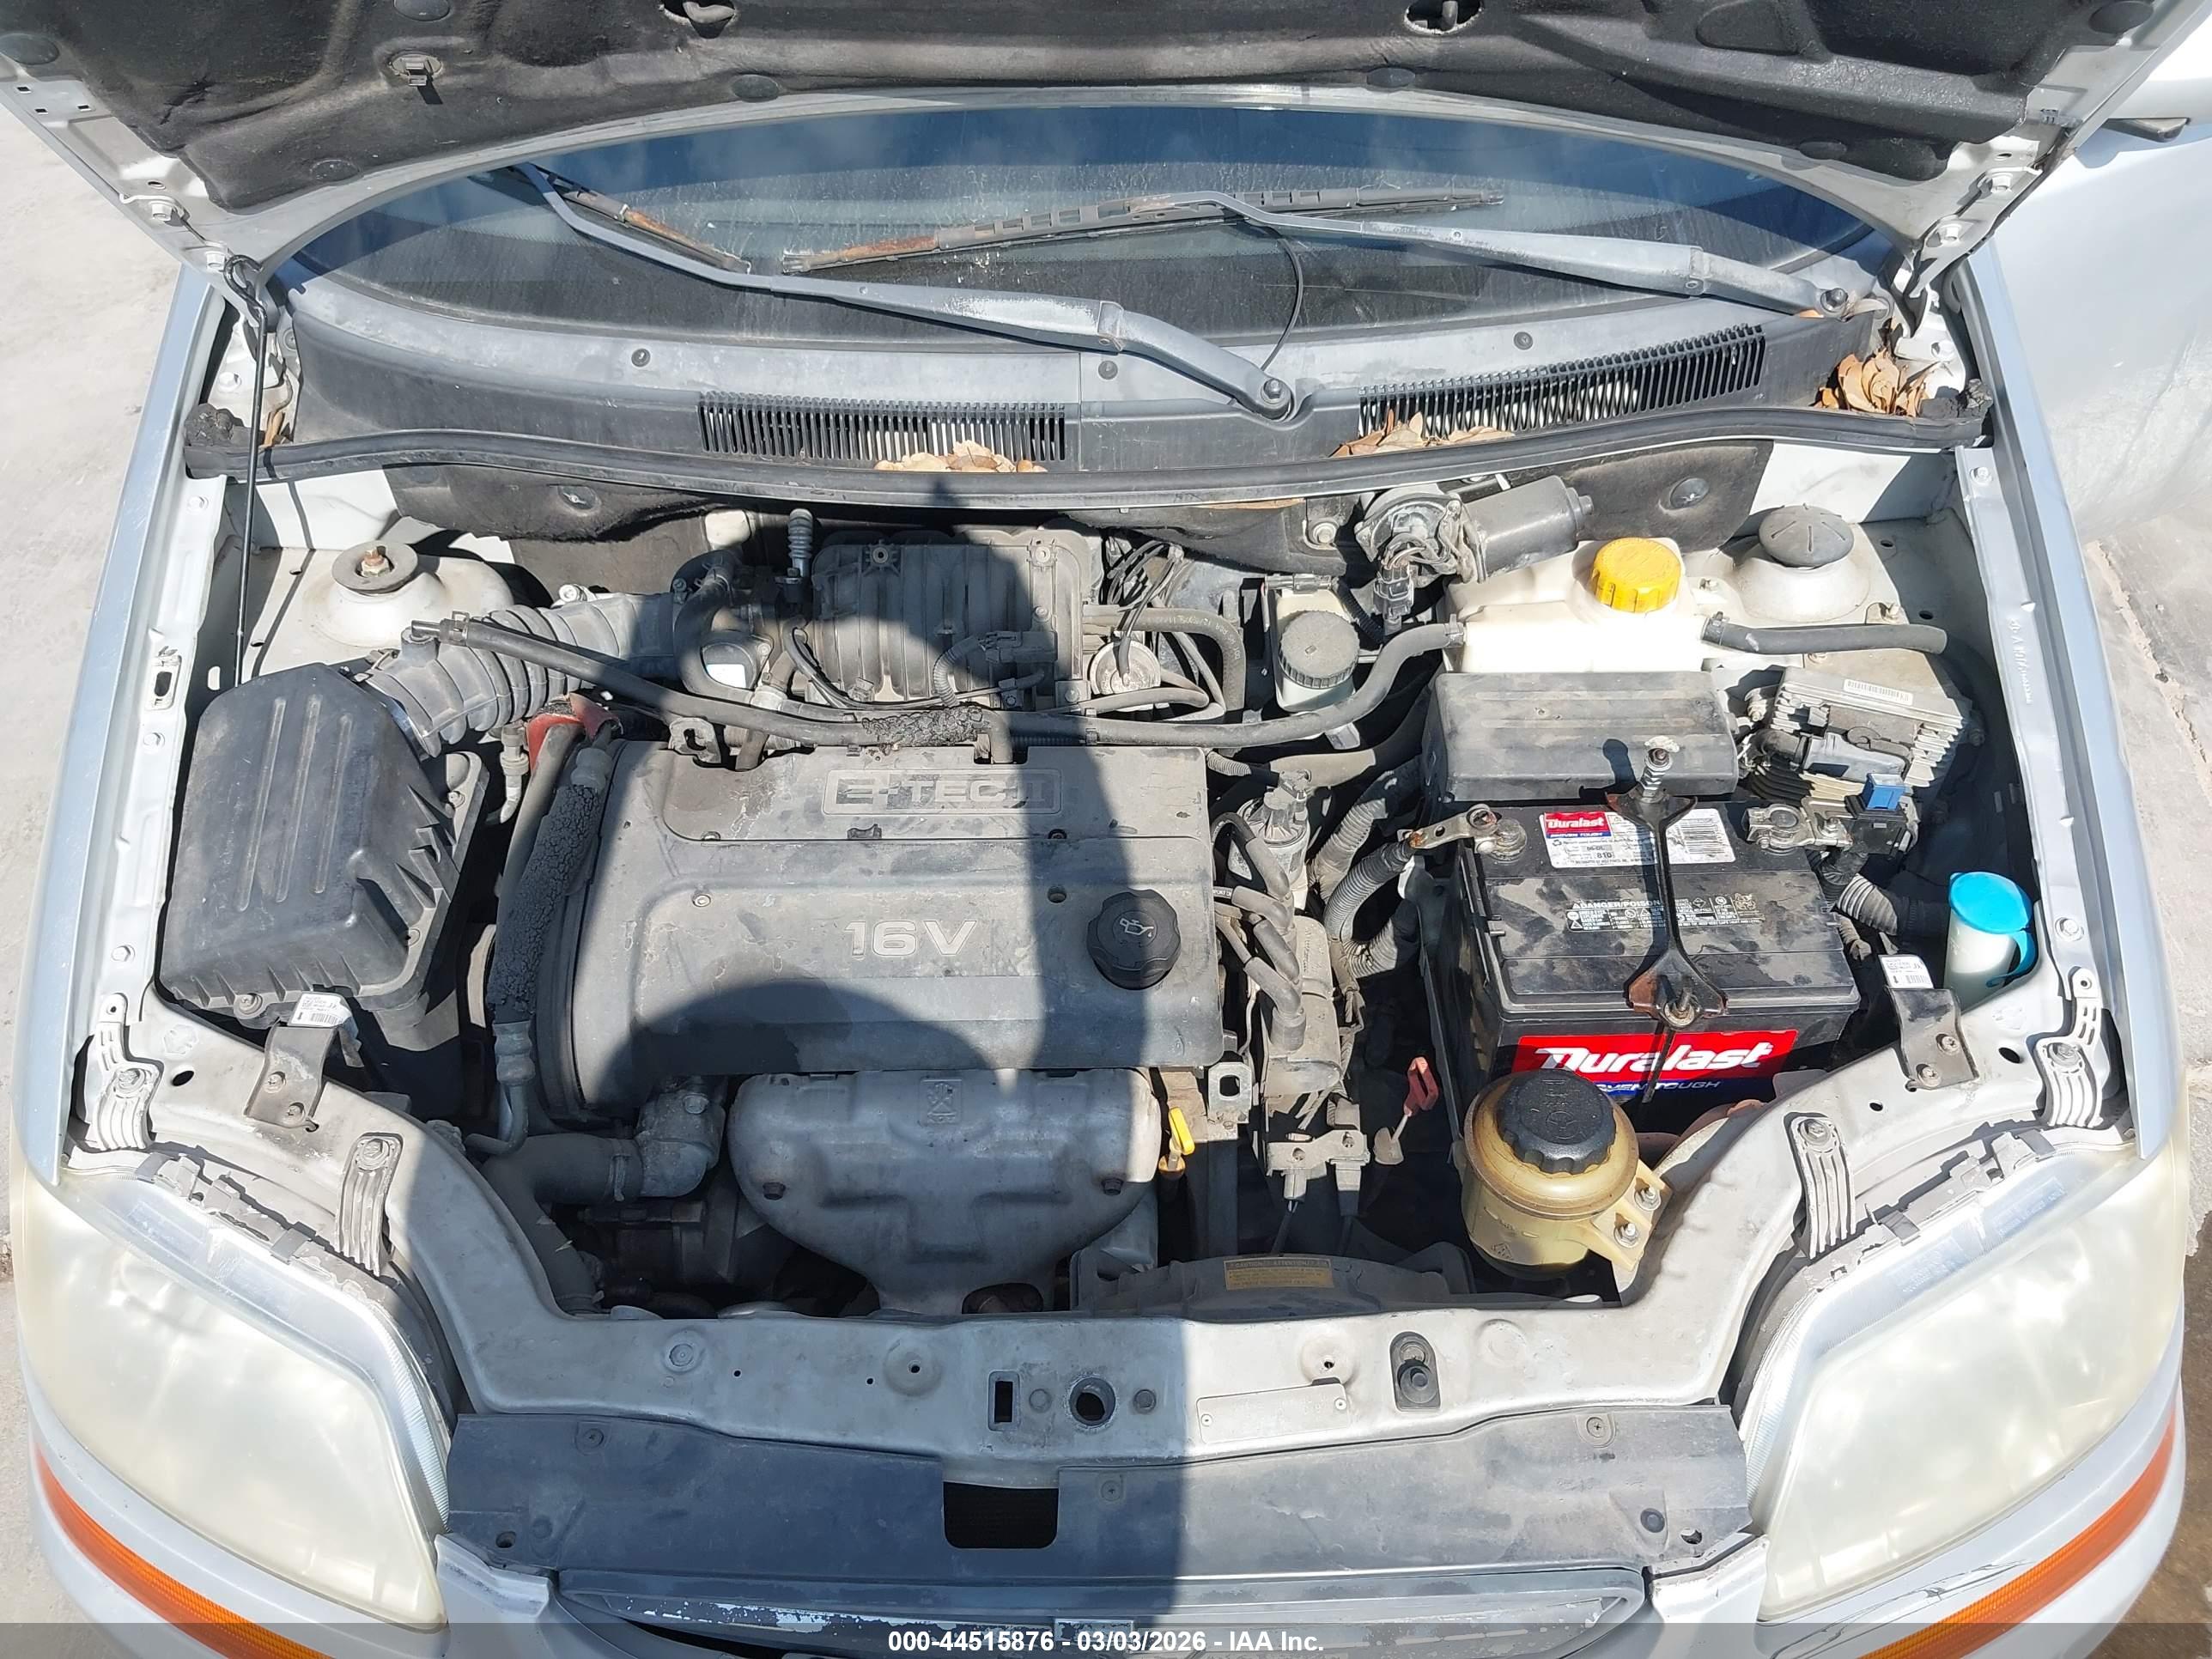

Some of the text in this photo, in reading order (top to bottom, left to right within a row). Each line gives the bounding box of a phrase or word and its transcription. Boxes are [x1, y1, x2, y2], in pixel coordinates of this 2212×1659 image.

[1545, 817, 1605, 829] Duralast
[844, 919, 978, 957] 16V
[1535, 1042, 1773, 1073] Duralast
